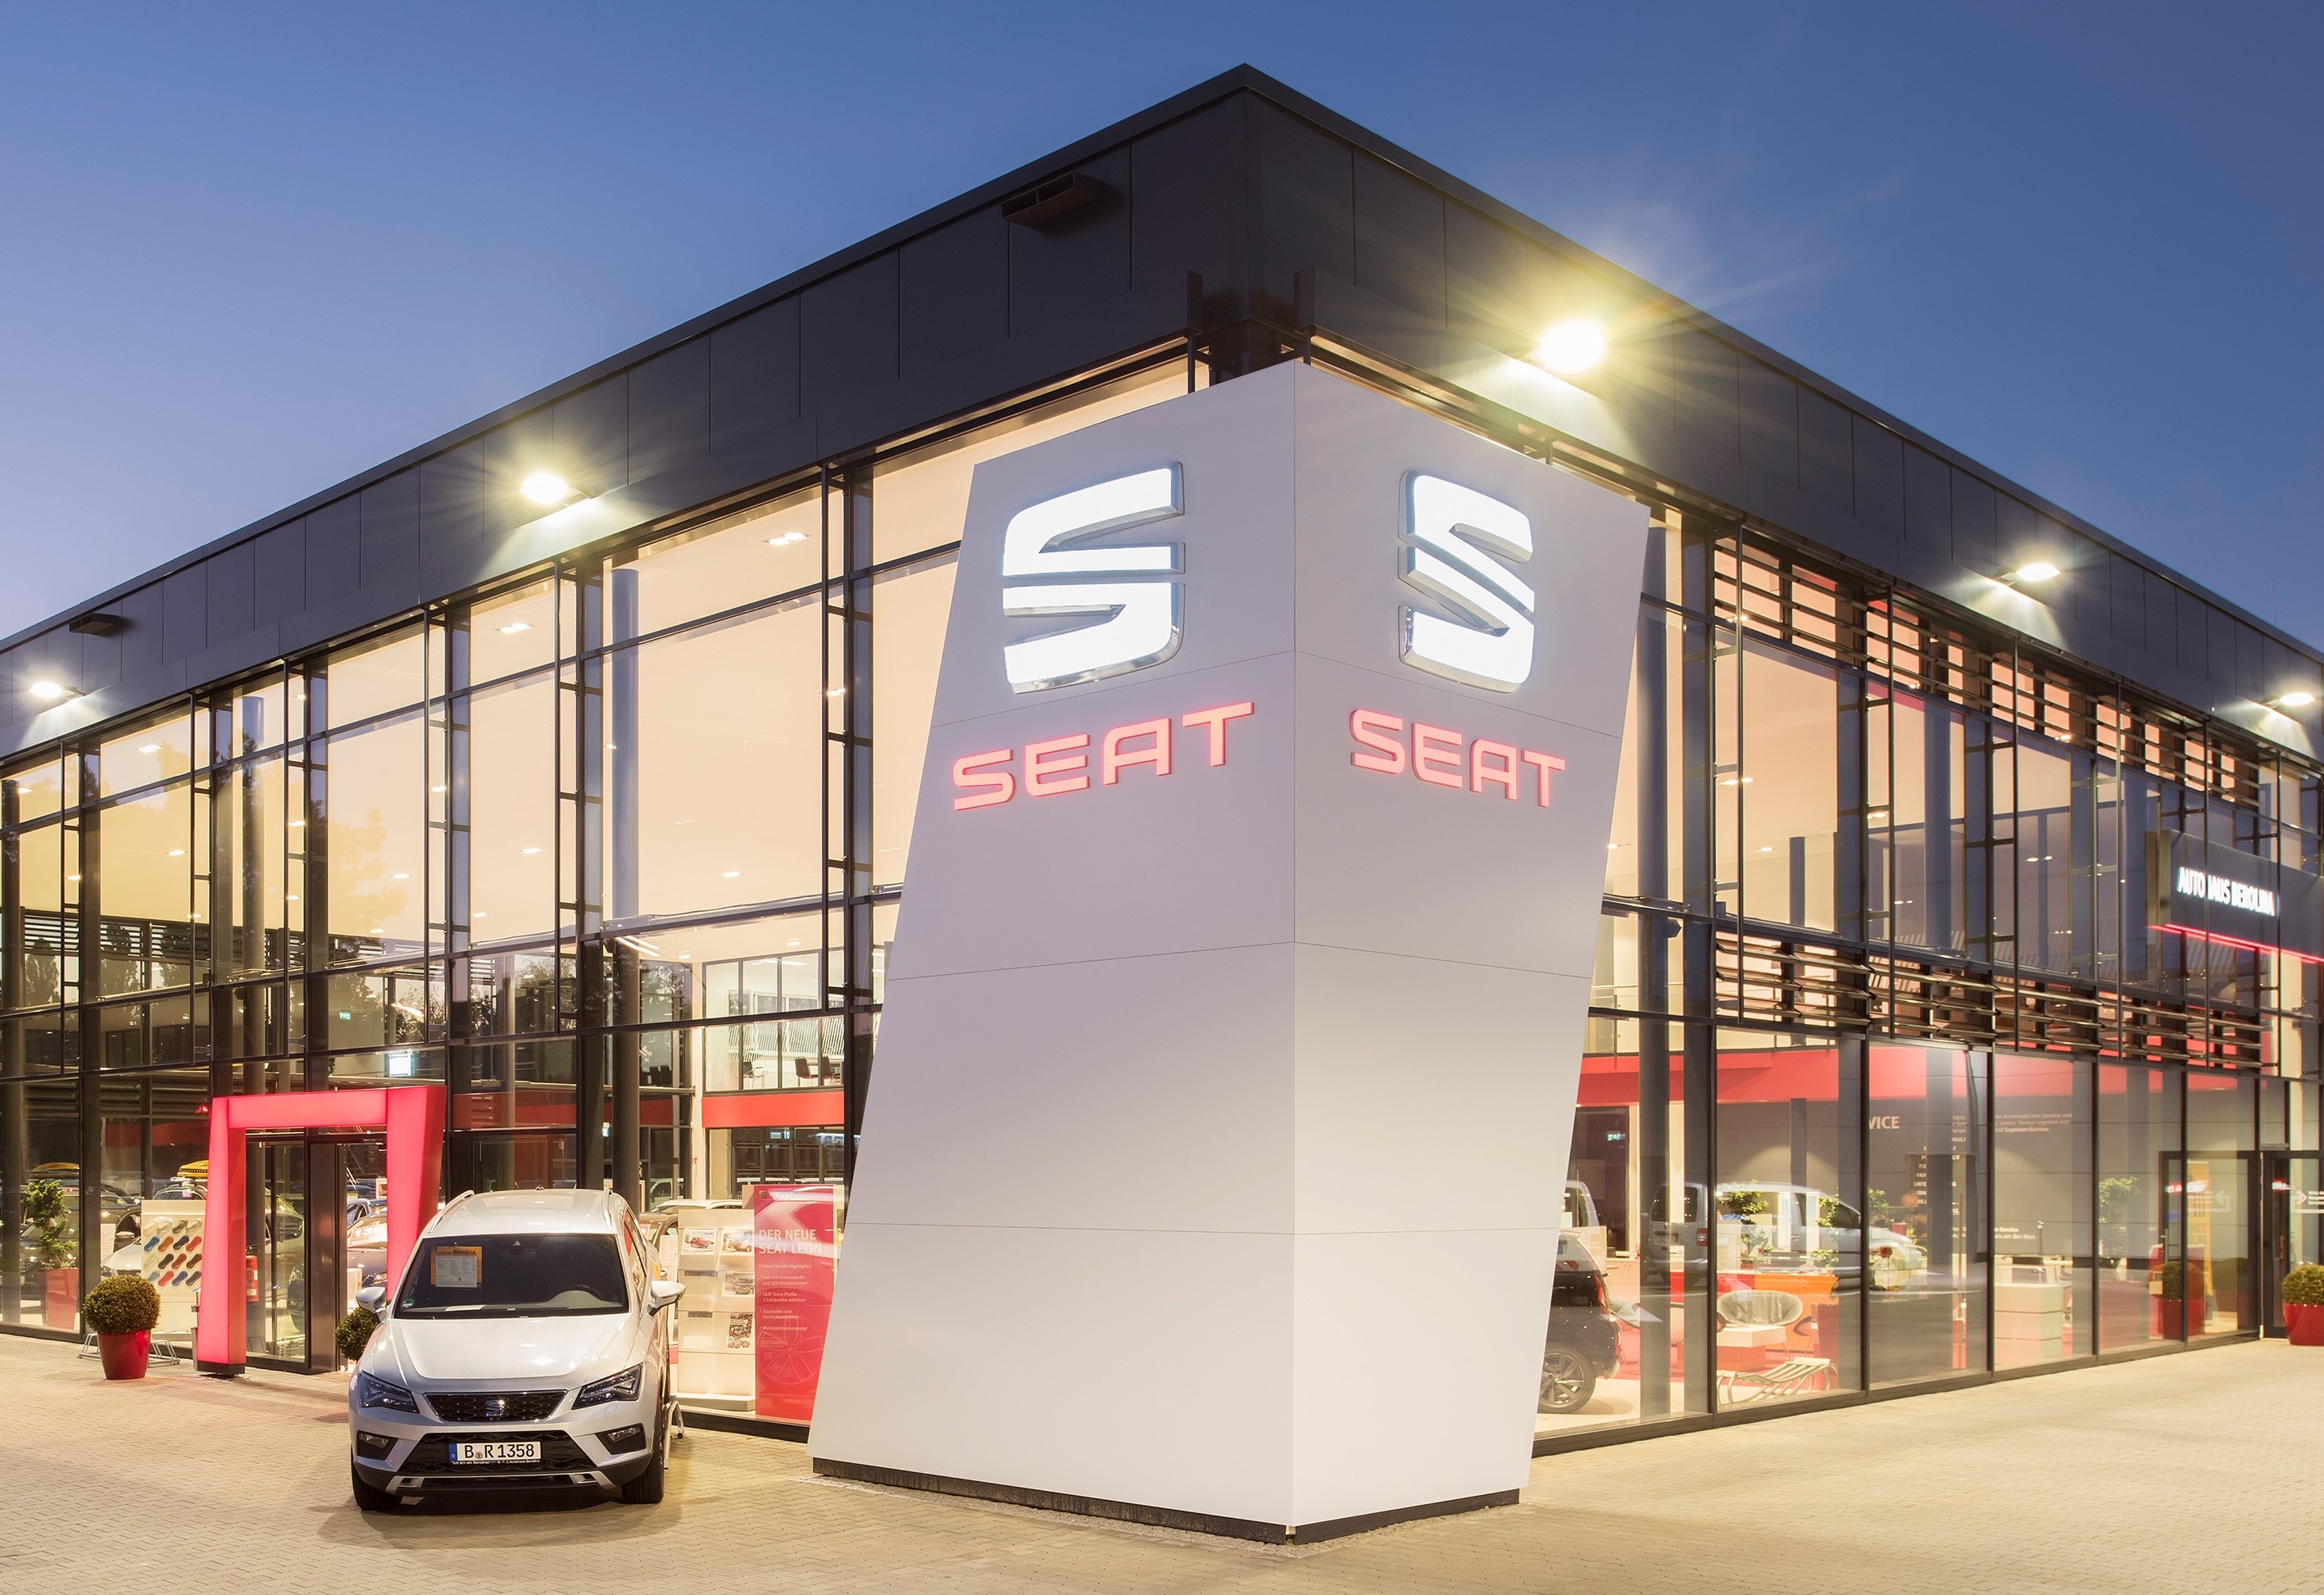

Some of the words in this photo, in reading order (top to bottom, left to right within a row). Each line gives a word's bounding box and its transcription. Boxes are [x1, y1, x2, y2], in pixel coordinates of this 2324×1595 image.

[952, 701, 1255, 810] SEAT
[1349, 708, 1566, 808] SEAT
[2231, 881, 2276, 917] BEROLINA
[759, 1229, 782, 1240] DER
[785, 1229, 817, 1240] NEUE
[759, 1243, 788, 1254] SEAT
[791, 1243, 822, 1254] LEON
[465, 1445, 474, 1458] B
[484, 1445, 493, 1458] R
[497, 1444, 534, 1458] 1358
